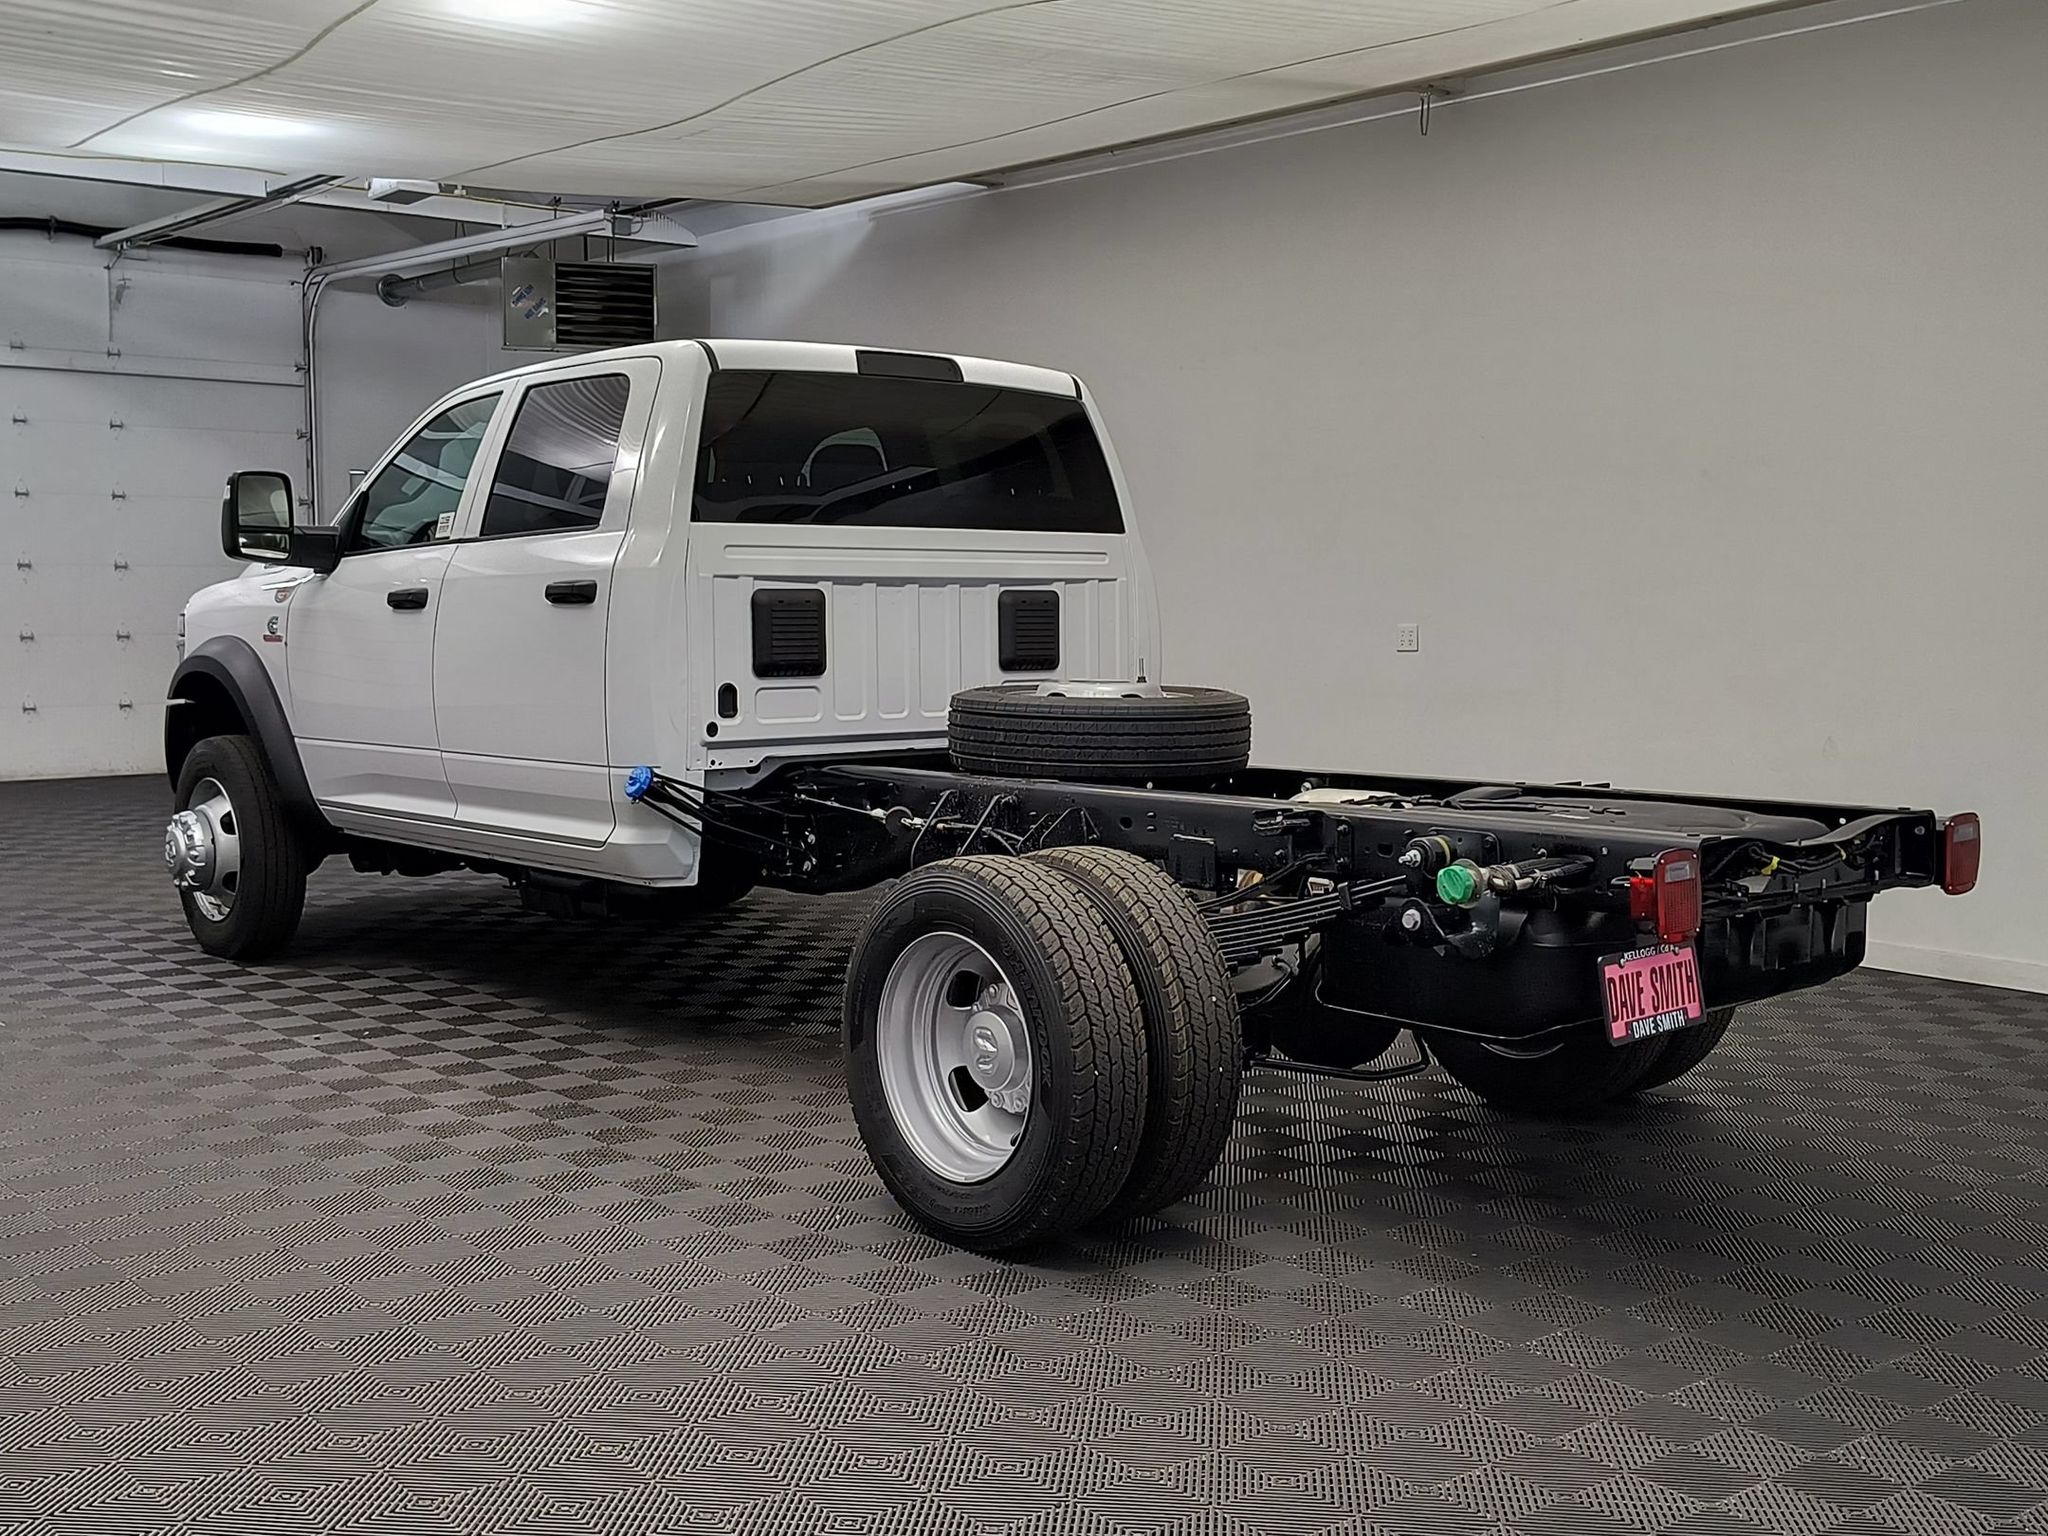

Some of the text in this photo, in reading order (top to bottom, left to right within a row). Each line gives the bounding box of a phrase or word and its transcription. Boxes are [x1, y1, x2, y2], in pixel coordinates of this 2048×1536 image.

[1623, 946, 1655, 961] KELLOGG
[1607, 960, 1696, 1022] DAVE SMITH
[1633, 1010, 1685, 1039] DAVE SMITH
